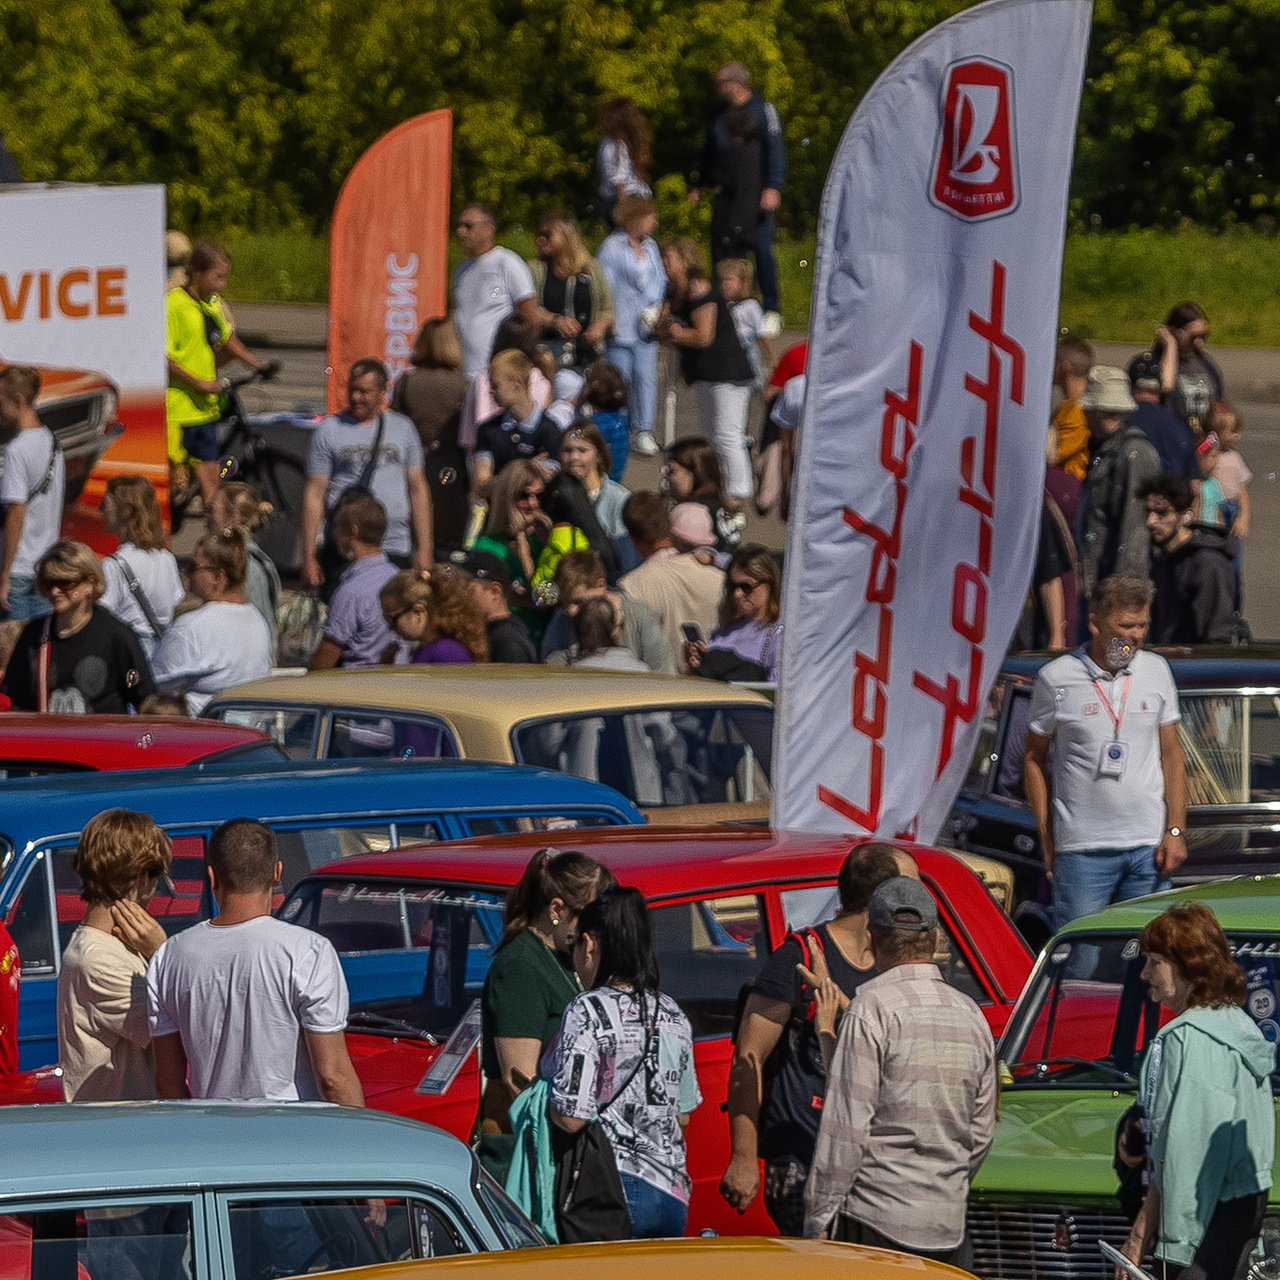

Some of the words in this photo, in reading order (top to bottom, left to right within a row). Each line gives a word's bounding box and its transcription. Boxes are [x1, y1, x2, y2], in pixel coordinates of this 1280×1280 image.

[0, 267, 127, 321] VICE
[912, 258, 1026, 783] tory
[817, 337, 924, 834] Lada
